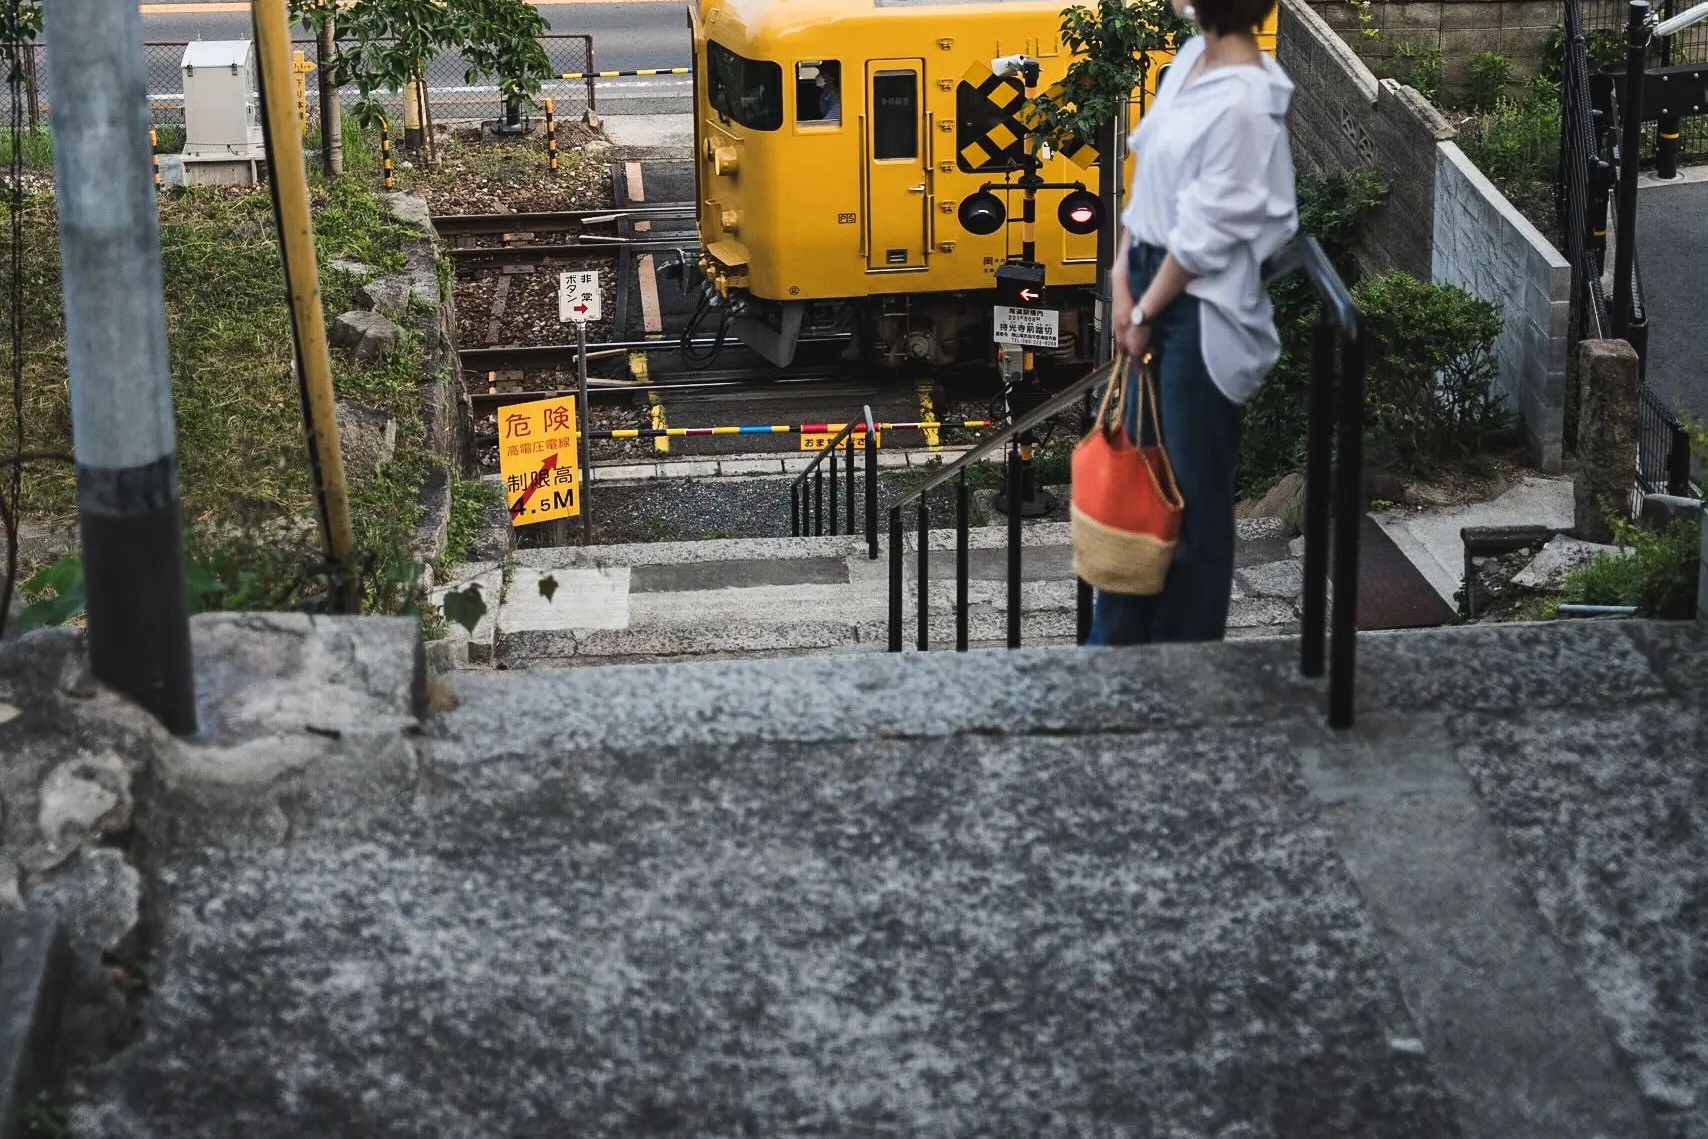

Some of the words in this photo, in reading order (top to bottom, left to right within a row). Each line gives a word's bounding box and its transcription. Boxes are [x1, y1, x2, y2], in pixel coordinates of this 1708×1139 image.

[565, 274, 578, 303] ボタン
[580, 273, 593, 302] 非常
[999, 322, 1053, 336] 持光寺前踏切
[505, 405, 570, 439] 危険
[507, 437, 571, 457] 高電圧電線
[507, 465, 573, 493] 制限高
[510, 488, 574, 516] 4.5M
